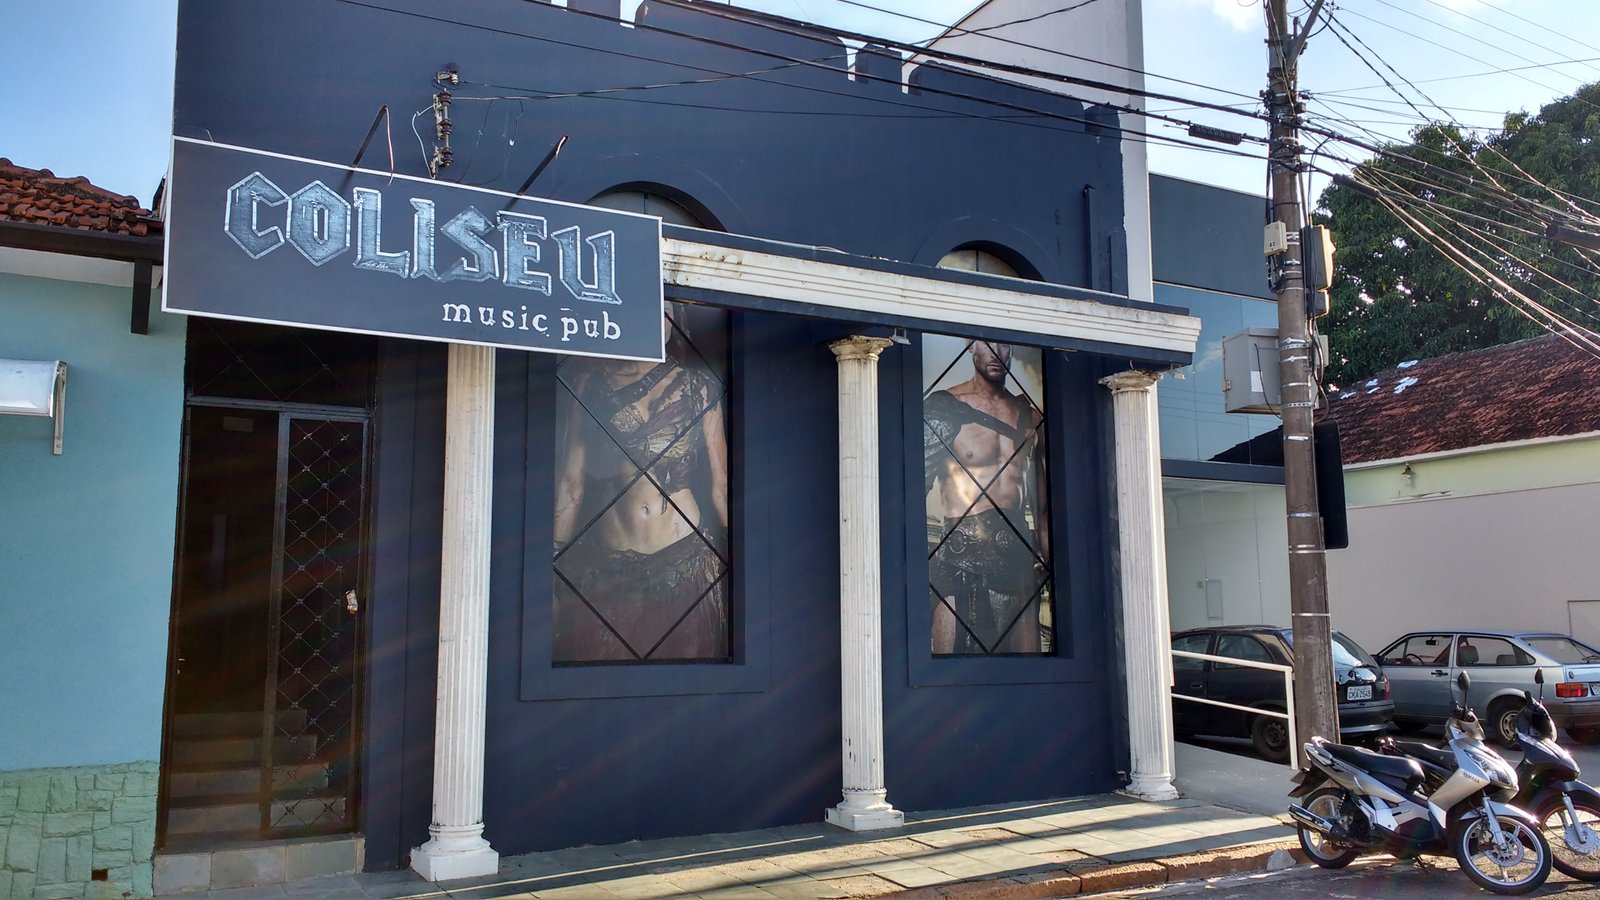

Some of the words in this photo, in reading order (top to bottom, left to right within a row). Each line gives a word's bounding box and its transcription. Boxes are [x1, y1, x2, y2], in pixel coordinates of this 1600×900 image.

[223, 171, 623, 305] COLISEU
[442, 302, 550, 336] music
[560, 309, 622, 342] pub
